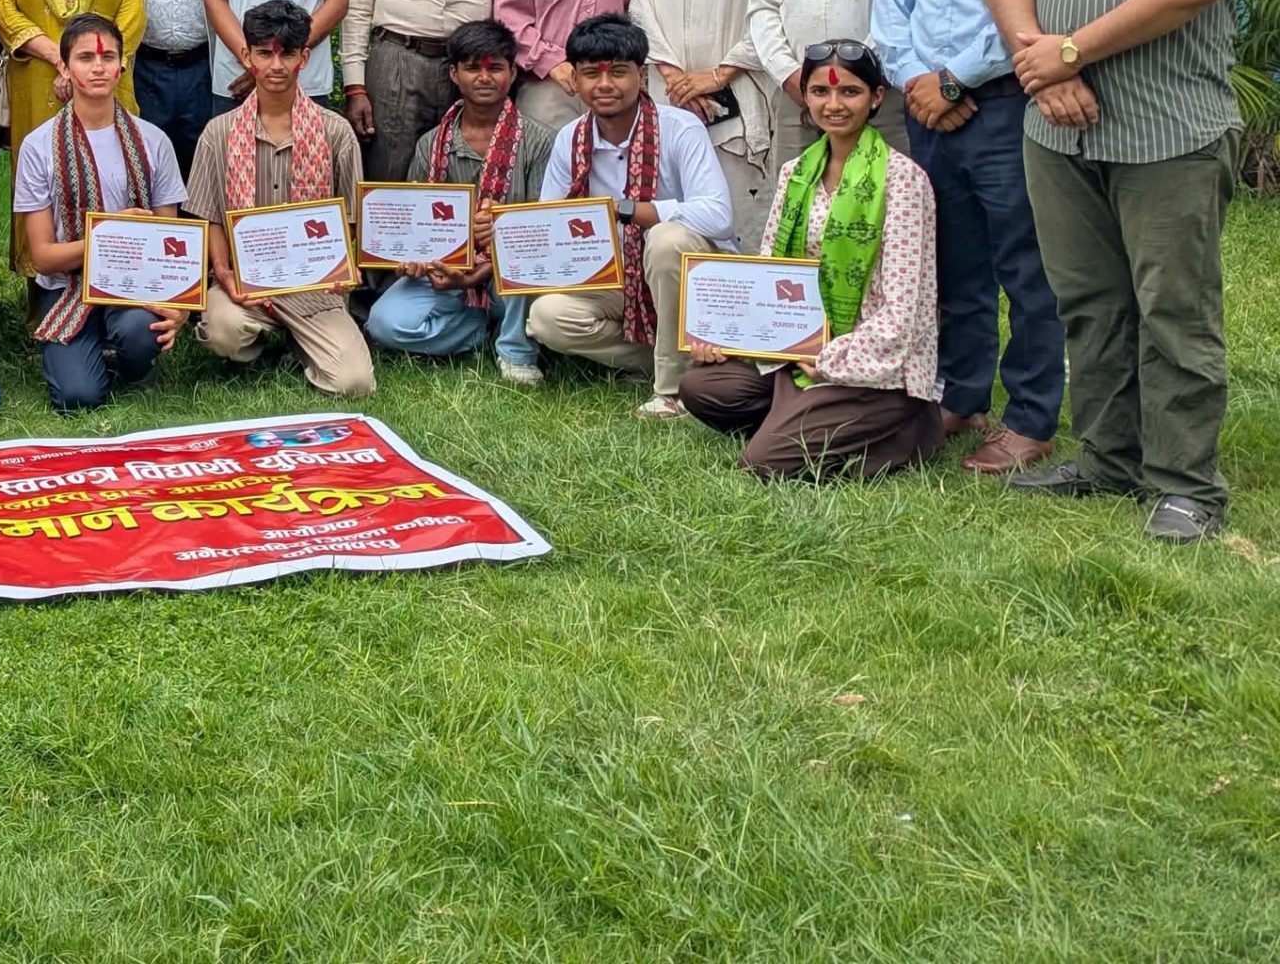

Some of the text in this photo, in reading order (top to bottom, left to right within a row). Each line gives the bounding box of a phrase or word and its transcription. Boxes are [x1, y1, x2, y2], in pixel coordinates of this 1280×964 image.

[125, 458, 245, 482] विद्यार्थी
[250, 447, 386, 472] युनियन
[143, 482, 448, 523] कार्यक्रम
[260, 518, 360, 541] आयोजक
